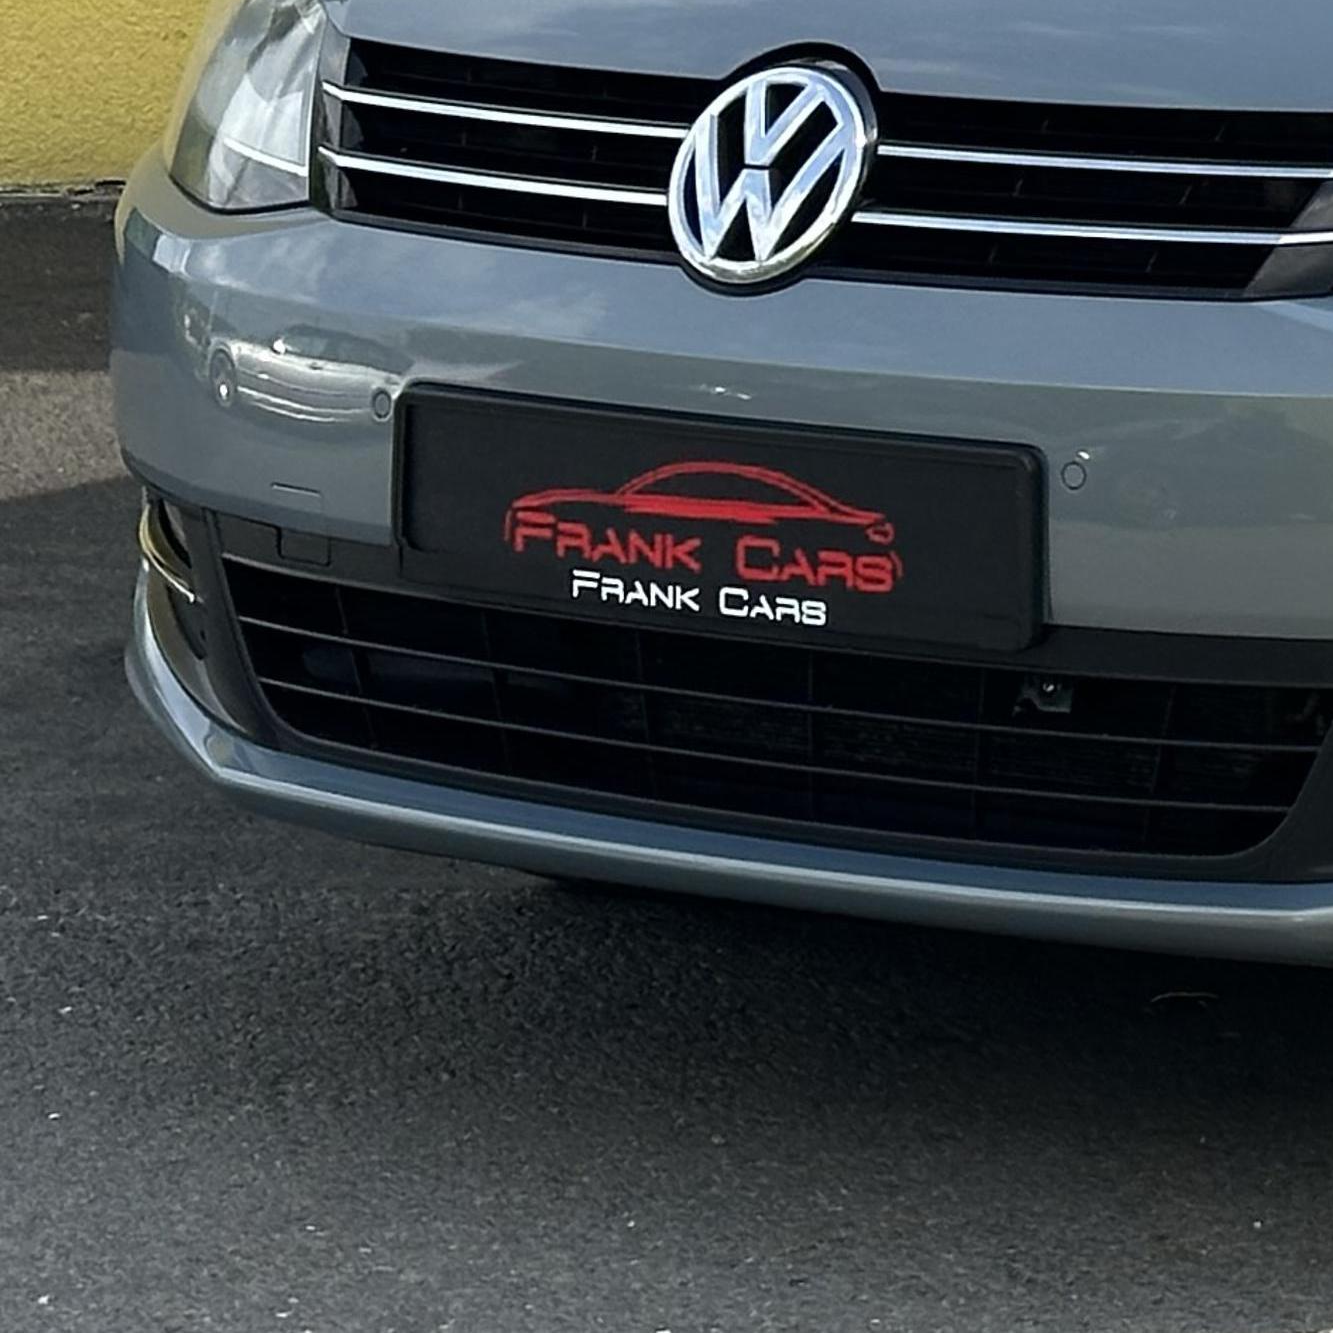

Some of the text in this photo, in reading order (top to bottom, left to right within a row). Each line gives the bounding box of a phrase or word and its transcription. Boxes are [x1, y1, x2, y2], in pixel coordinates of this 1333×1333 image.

[678, 71, 858, 274] VW
[513, 511, 893, 594] FRANK CARS
[572, 569, 827, 626] FRANK CARS
